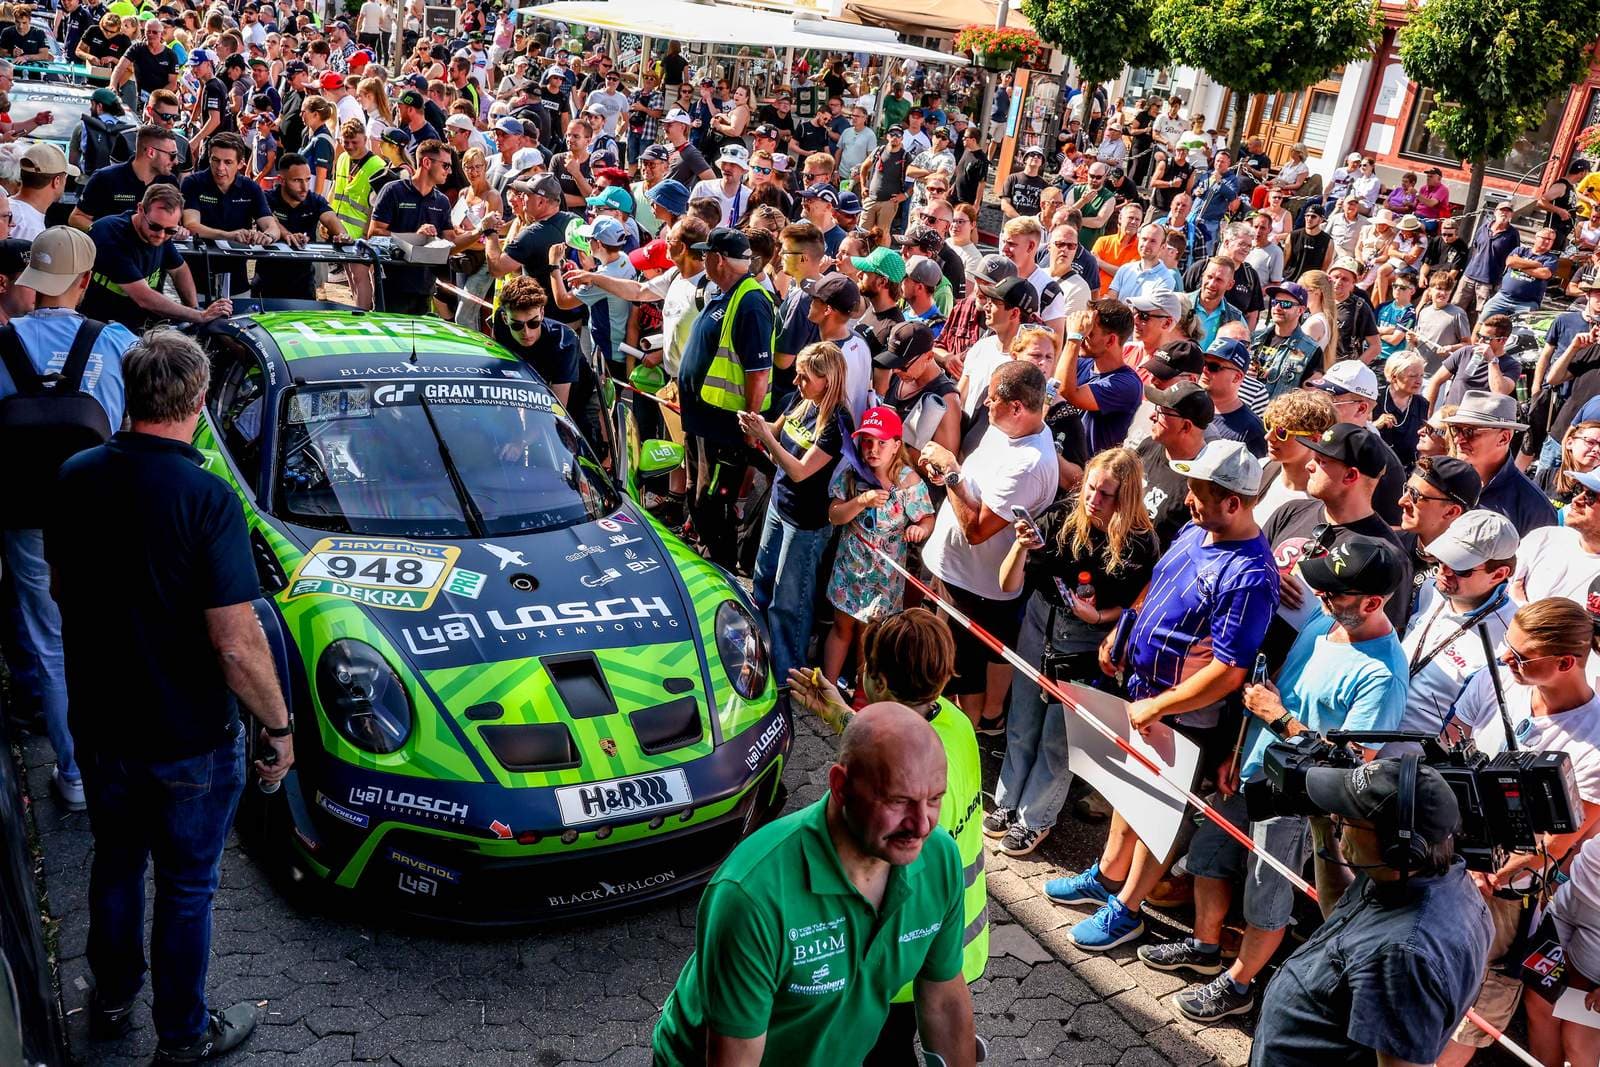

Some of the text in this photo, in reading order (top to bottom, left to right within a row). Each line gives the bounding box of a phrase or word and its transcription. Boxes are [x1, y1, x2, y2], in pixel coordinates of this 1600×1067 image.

[339, 366, 492, 377] BLACK FALCON
[424, 384, 475, 399] GRAN
[479, 385, 552, 407] TURISMO
[473, 398, 509, 407] DRIVING
[863, 419, 883, 427] DEKRA
[339, 542, 440, 556] RAVENOL
[327, 556, 424, 585] 948
[450, 570, 480, 596] PRO
[331, 584, 416, 607] DEKRA
[486, 596, 673, 631] LOSCH
[500, 618, 680, 644] LUXEMBOURG
[758, 713, 786, 752] LOSCH
[385, 790, 469, 819] LOSCH
[578, 780, 643, 818] H&R
[327, 803, 364, 823] MICHELIN
[383, 804, 465, 826] LUXEMBOURG
[391, 851, 454, 881] RAVENOL
[549, 870, 676, 906] BLACK FALCON
